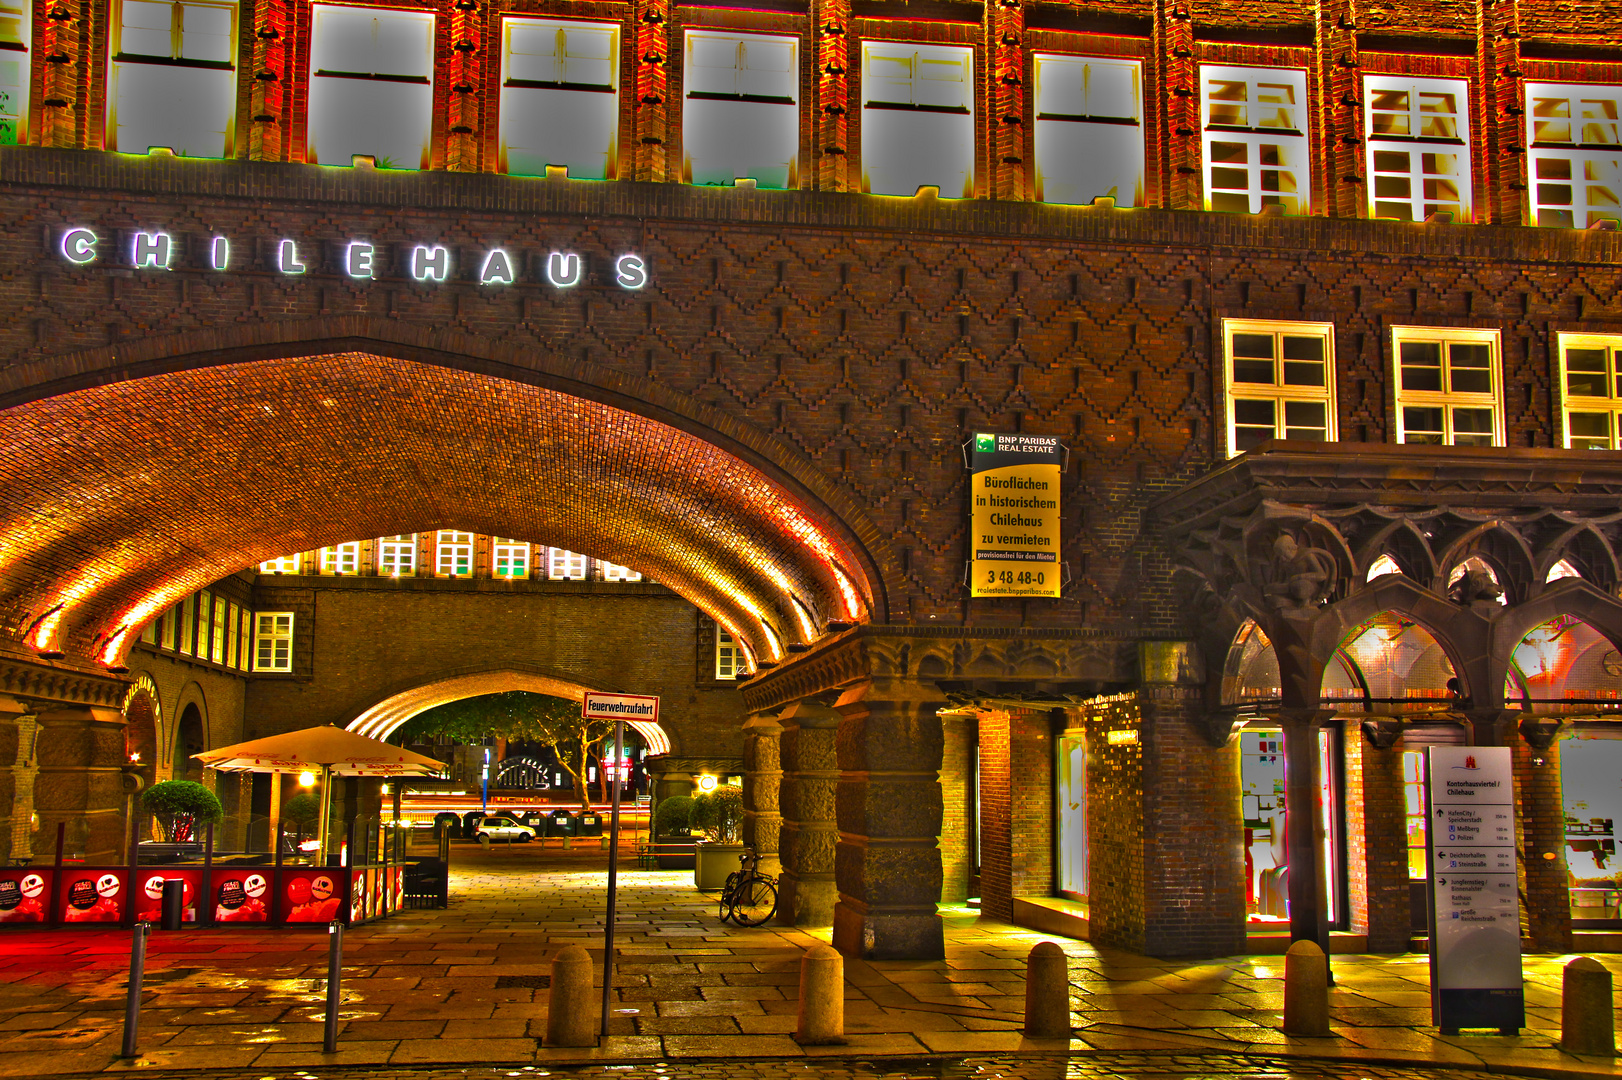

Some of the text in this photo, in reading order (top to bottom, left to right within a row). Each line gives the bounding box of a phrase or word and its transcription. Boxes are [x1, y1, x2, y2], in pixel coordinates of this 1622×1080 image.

[62, 228, 647, 288] CHILEHAUS
[998, 436, 1057, 446] BNP PARIBAS
[998, 444, 1054, 454] REAL ESTATE
[984, 475, 1048, 490] Büroflächen
[976, 493, 1056, 509] in historischem
[990, 512, 1043, 527] Chilehaus
[982, 533, 1051, 546] zu vermieten
[977, 551, 1015, 560] provisionsfrei
[1025, 552, 1036, 560] den
[988, 570, 1045, 585] 3 48 48-0
[588, 699, 653, 715] Feuerwehrzufahrt
[1447, 780, 1497, 788] Kontorhausviertel
[1447, 788, 1475, 796] Chilehaus
[1447, 810, 1473, 818] HafenCity
[1457, 825, 1480, 833] Meßberg
